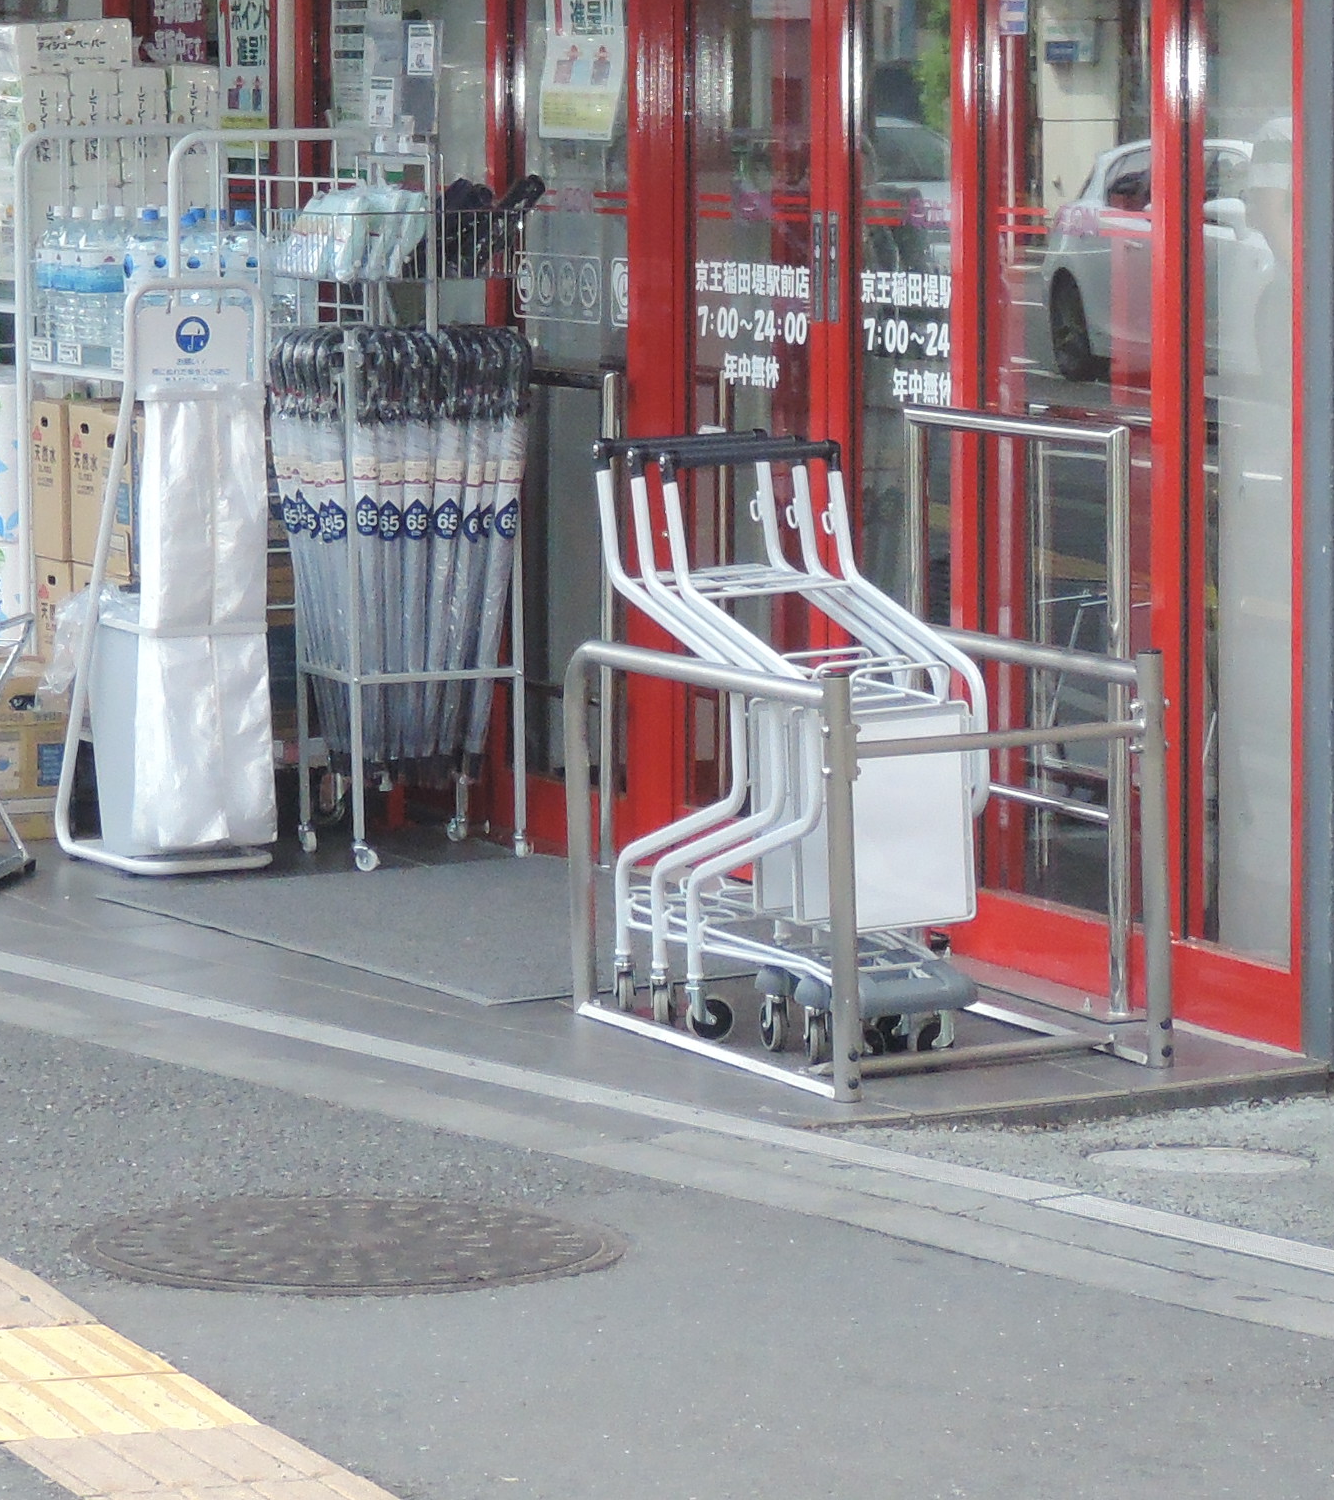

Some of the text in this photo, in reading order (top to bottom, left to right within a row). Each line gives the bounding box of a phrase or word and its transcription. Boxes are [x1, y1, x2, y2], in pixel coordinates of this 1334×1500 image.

[695, 260, 810, 299] 京王稲田堤駅前店
[723, 353, 780, 389] 年中無休
[357, 509, 378, 526] 65
[380, 515, 400, 531] 65
[406, 514, 427, 530] 65
[437, 513, 458, 529] 65
